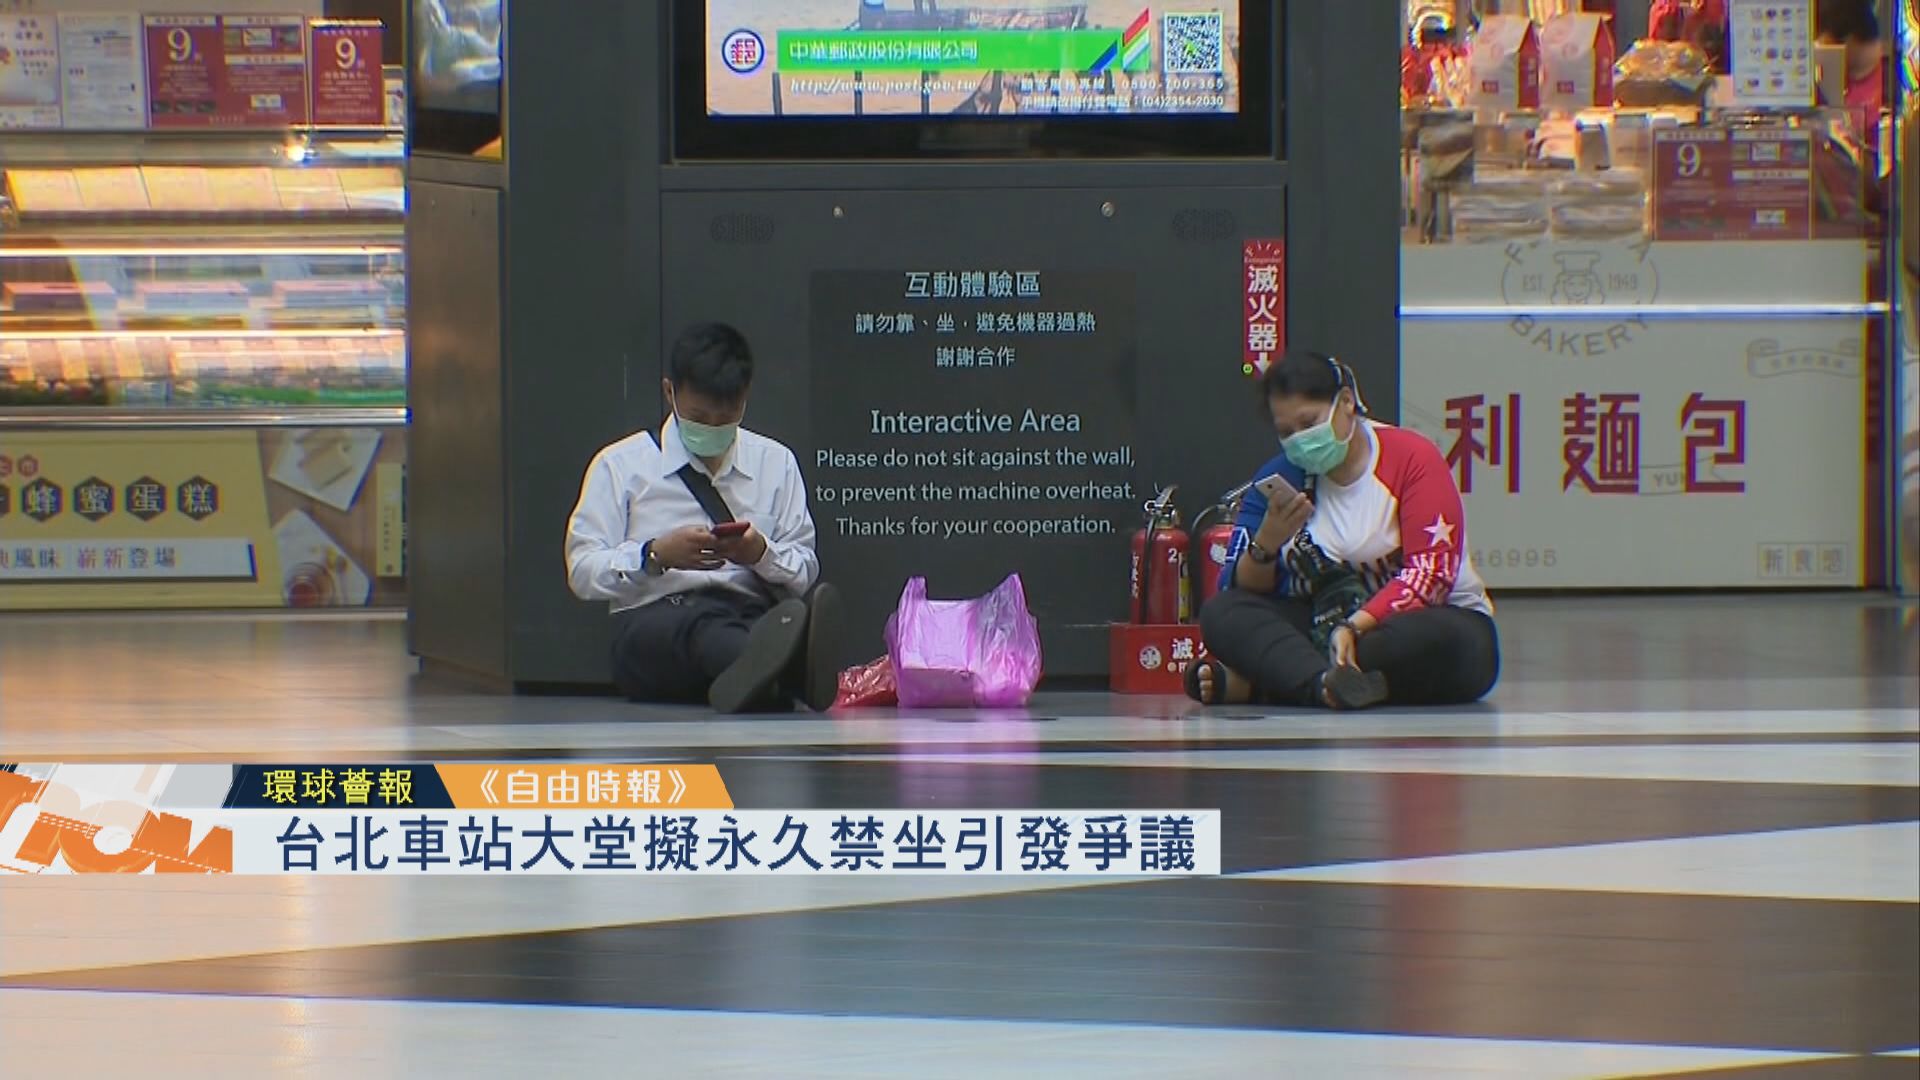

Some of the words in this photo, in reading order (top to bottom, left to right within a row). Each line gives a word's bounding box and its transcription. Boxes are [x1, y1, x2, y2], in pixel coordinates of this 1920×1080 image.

[788, 38, 979, 61] 中華郵政股份有限公司
[905, 271, 1041, 298] 互動體驗區
[1247, 265, 1279, 352] 滅火器
[1510, 314, 1649, 357] BAKERY
[936, 346, 1016, 368] 謝謝合作
[871, 407, 1013, 433] Interactive
[1019, 407, 1081, 433] Area
[816, 449, 878, 467] Please
[883, 448, 909, 467] do
[914, 449, 947, 467] not
[952, 448, 975, 466] sit
[980, 447, 1051, 471] against
[1055, 446, 1087, 465] the
[1092, 446, 1136, 467] wall,
[815, 485, 836, 501] to
[842, 484, 916, 506] prevent
[921, 481, 953, 501] the
[958, 480, 1041, 500] machine
[1045, 480, 1137, 500] overheat.
[835, 516, 905, 535] Thanks
[910, 515, 939, 535] for
[943, 520, 989, 539] your
[993, 514, 1117, 538] cooperation.
